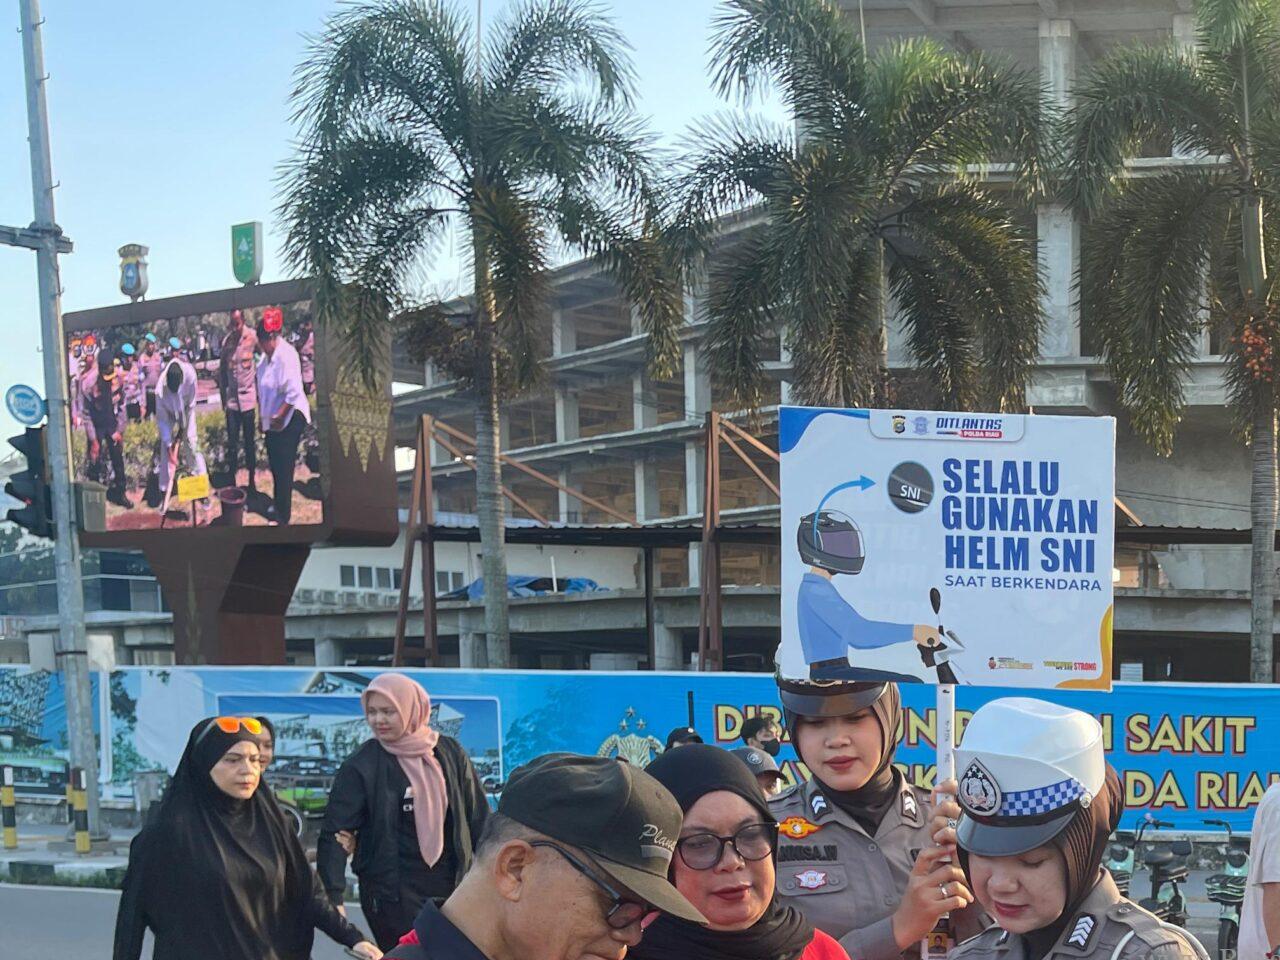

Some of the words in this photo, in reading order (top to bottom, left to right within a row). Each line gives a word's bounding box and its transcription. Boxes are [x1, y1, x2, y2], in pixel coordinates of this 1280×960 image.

[936, 417, 1002, 430] DITLANTAS
[900, 484, 921, 500] SNI
[942, 458, 1060, 496] SELALU
[941, 496, 1099, 534] GUNAKAN
[945, 535, 1030, 571] HELM
[1040, 538, 1096, 573] SNI
[945, 575, 987, 588] SAAT
[991, 576, 1102, 592] BERKENDARA
[1127, 713, 1256, 754] SAKIT
